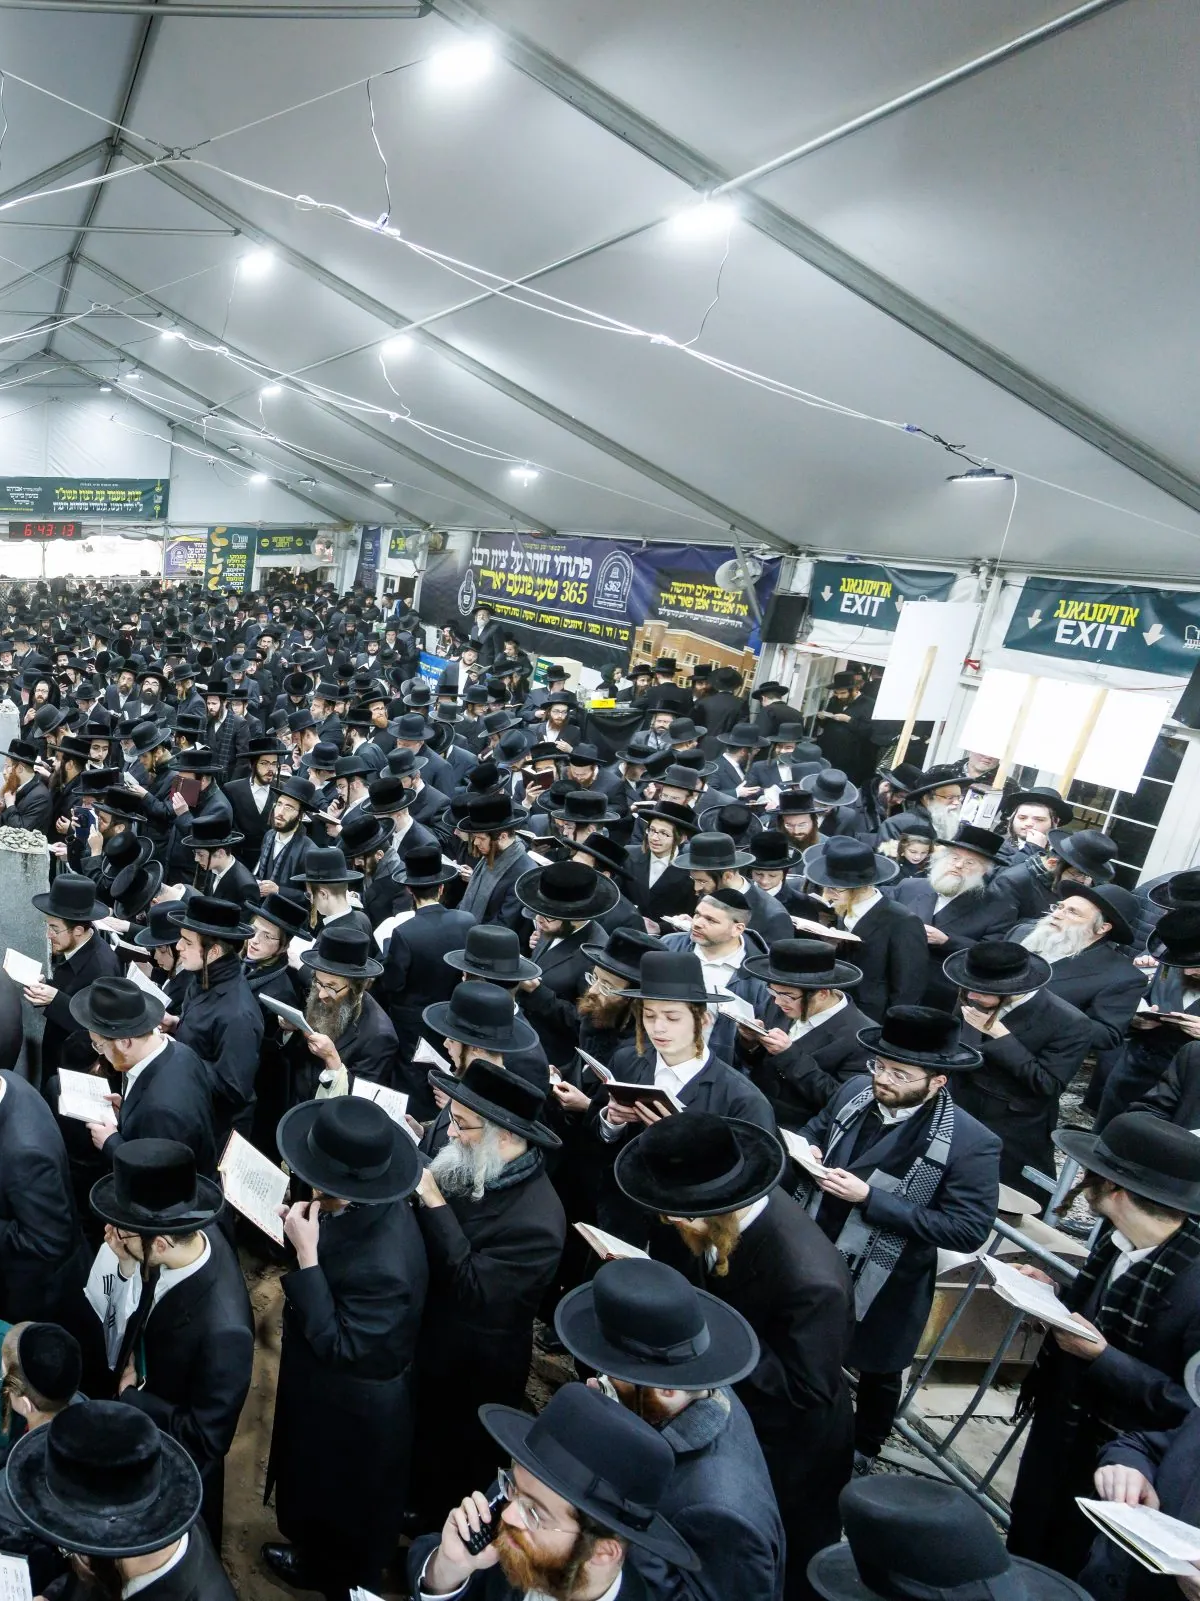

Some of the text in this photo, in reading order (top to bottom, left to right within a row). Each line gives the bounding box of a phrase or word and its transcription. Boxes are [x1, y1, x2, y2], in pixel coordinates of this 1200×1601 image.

[23, 524, 75, 537] 6:43:13
[491, 548, 509, 570] ציון
[510, 540, 524, 574] על
[553, 554, 593, 580] פתוחי
[560, 580, 589, 605] 365
[669, 581, 695, 595] ירושה
[839, 592, 886, 617] EXIT
[1054, 618, 1128, 651] EXIT
